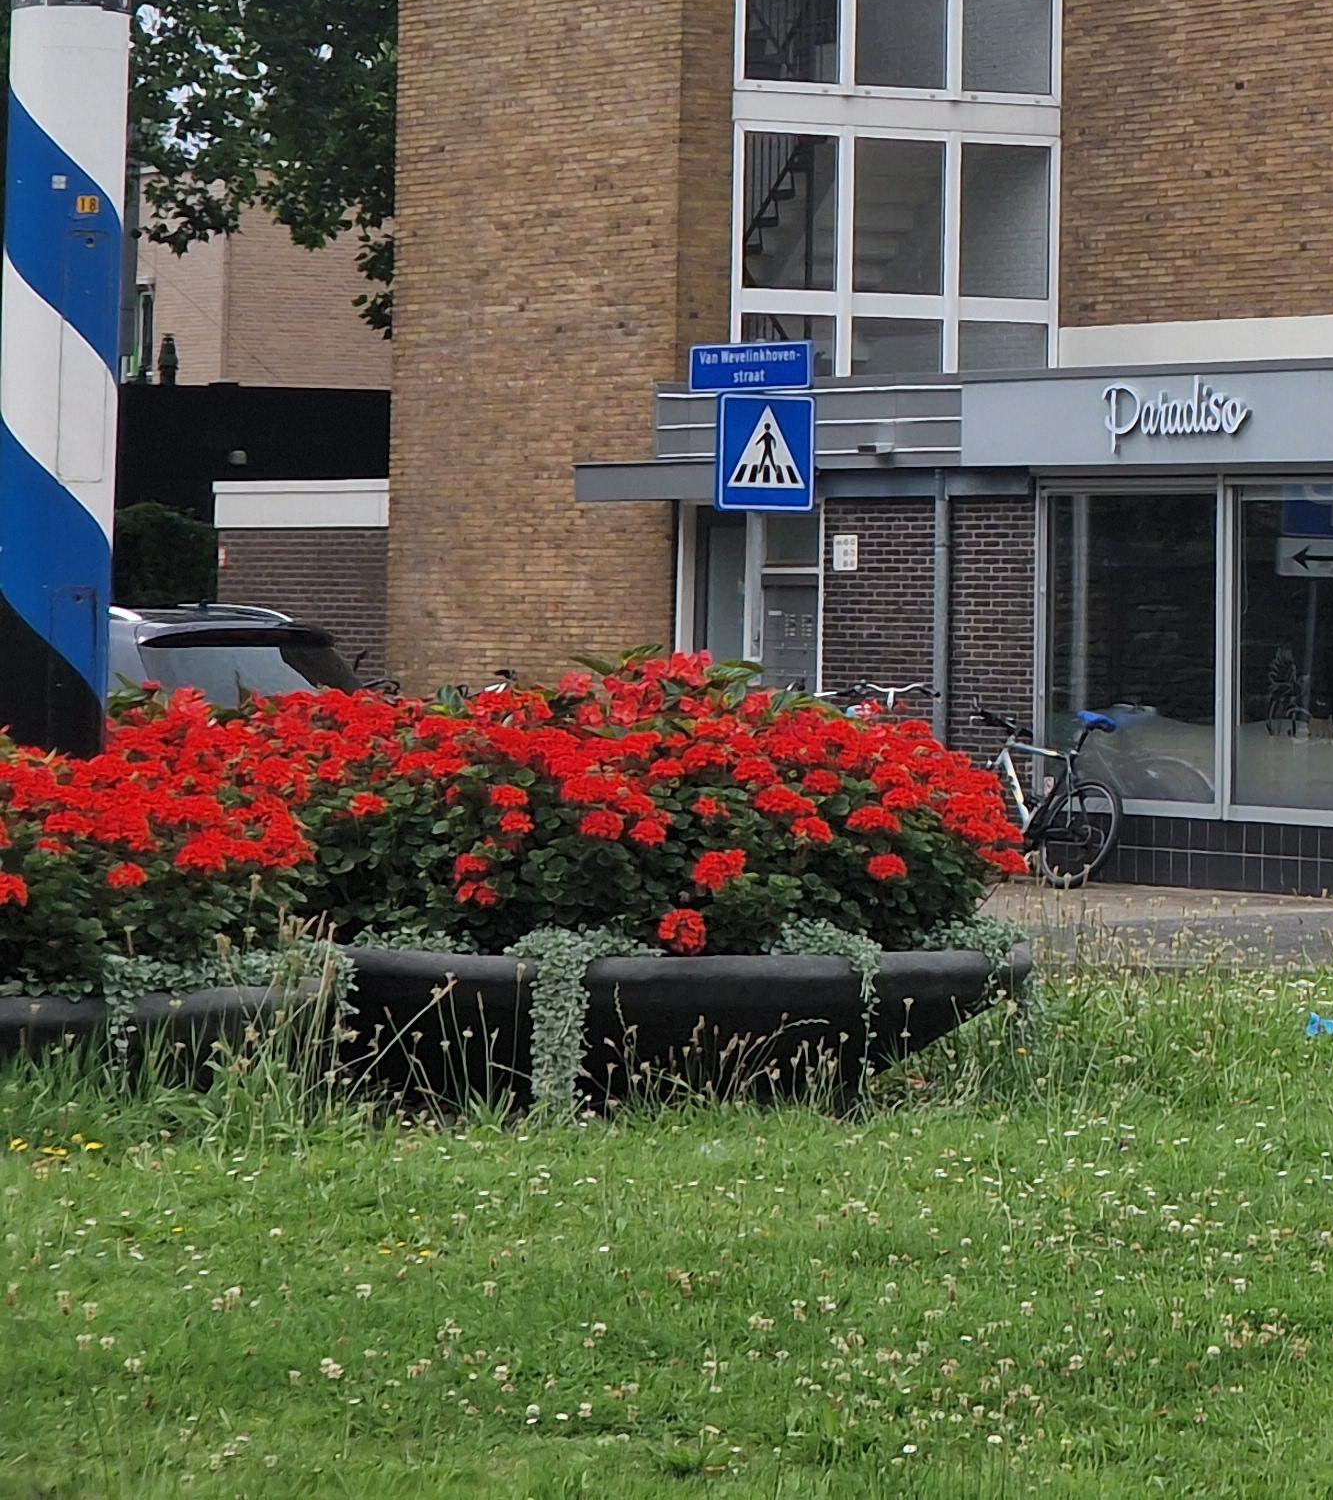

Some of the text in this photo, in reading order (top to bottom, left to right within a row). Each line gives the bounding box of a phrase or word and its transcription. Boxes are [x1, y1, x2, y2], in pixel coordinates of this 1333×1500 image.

[81, 197, 97, 212] 18
[699, 351, 719, 365] Van
[733, 369, 765, 383] straat
[1101, 374, 1253, 454] Paradiso
